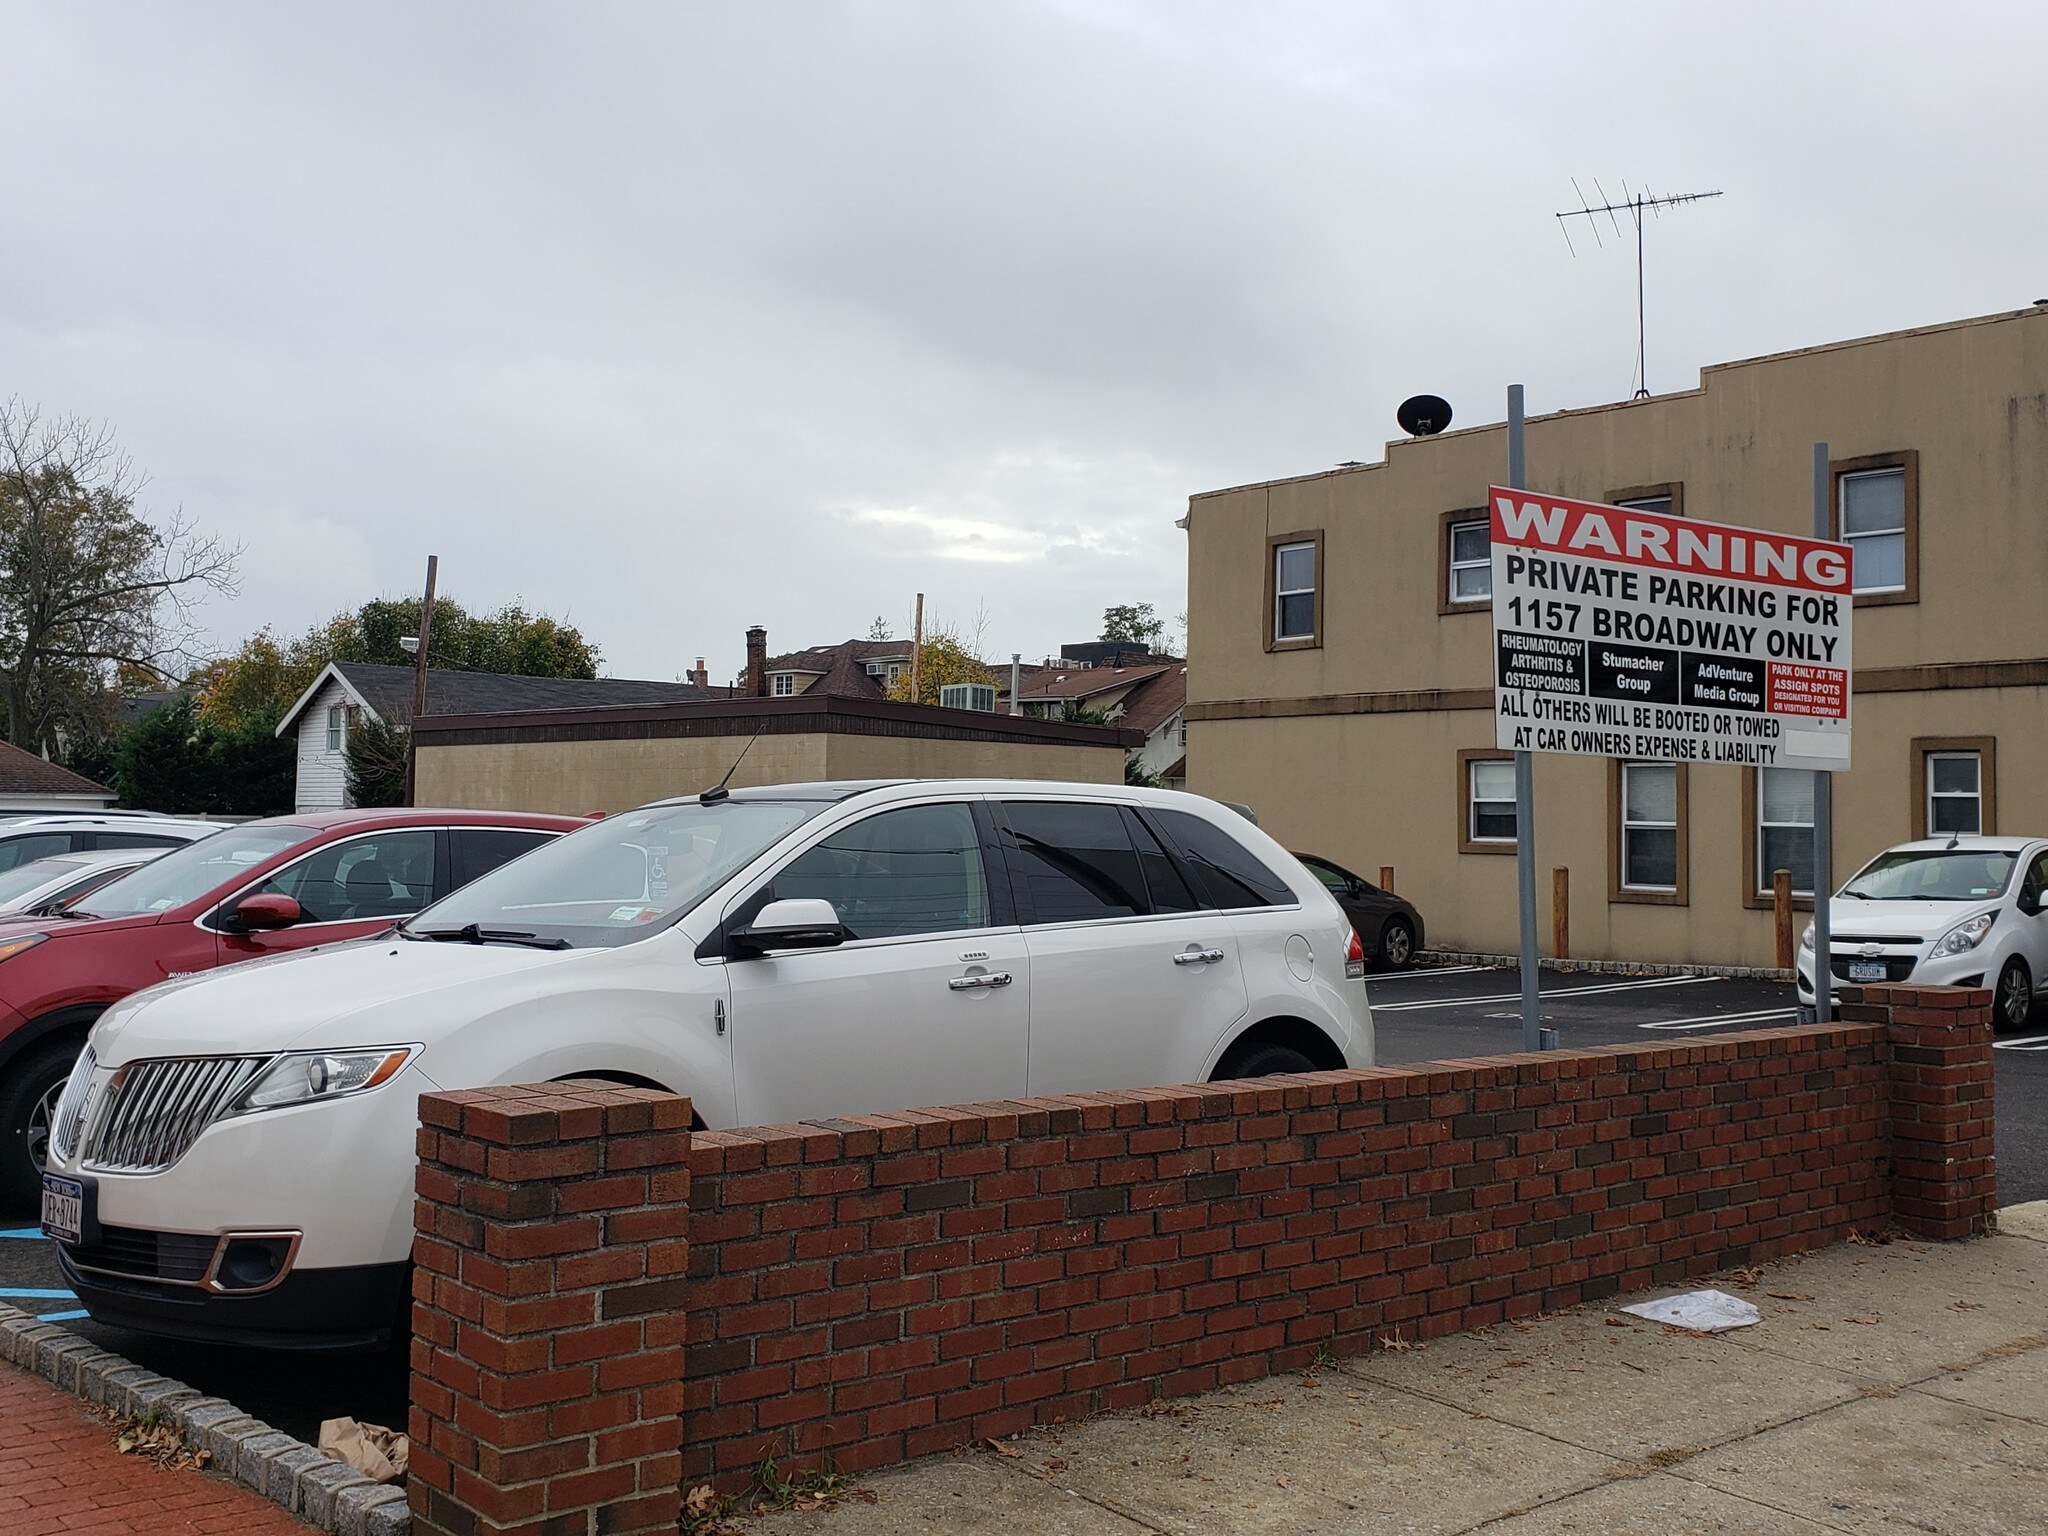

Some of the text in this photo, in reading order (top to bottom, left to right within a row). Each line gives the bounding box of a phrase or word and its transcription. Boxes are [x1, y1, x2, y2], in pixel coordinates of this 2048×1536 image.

[1495, 497, 1846, 587] WARNING
[1507, 554, 1839, 627] PRIVATE PARKING FOR
[1508, 596, 1838, 662] 1157 BROADWAY ONLY
[1502, 634, 1582, 656] RHEUMATOLOGY
[1511, 653, 1574, 673] ARTHRITIS &
[1602, 652, 1664, 671] Stumacher
[1505, 672, 1580, 693] OSTEOPOROSIS
[1698, 663, 1753, 682] AdVenture
[1772, 664, 1843, 682] PARK ONLY AT THE
[1617, 674, 1651, 694] Group
[1774, 679, 1840, 695] ASSIGN SPOTS
[1694, 684, 1759, 707] Media Group
[1774, 691, 1839, 705] DESIGNATED FOR YOU
[1500, 694, 1779, 738] ALL OTHERS WILL BE BOOTED OR TOWED
[1773, 702, 1841, 716] OR VISITING COMPANY
[1514, 726, 1776, 764] AT CAR OWNERS EXPENSE & LIABILITY
